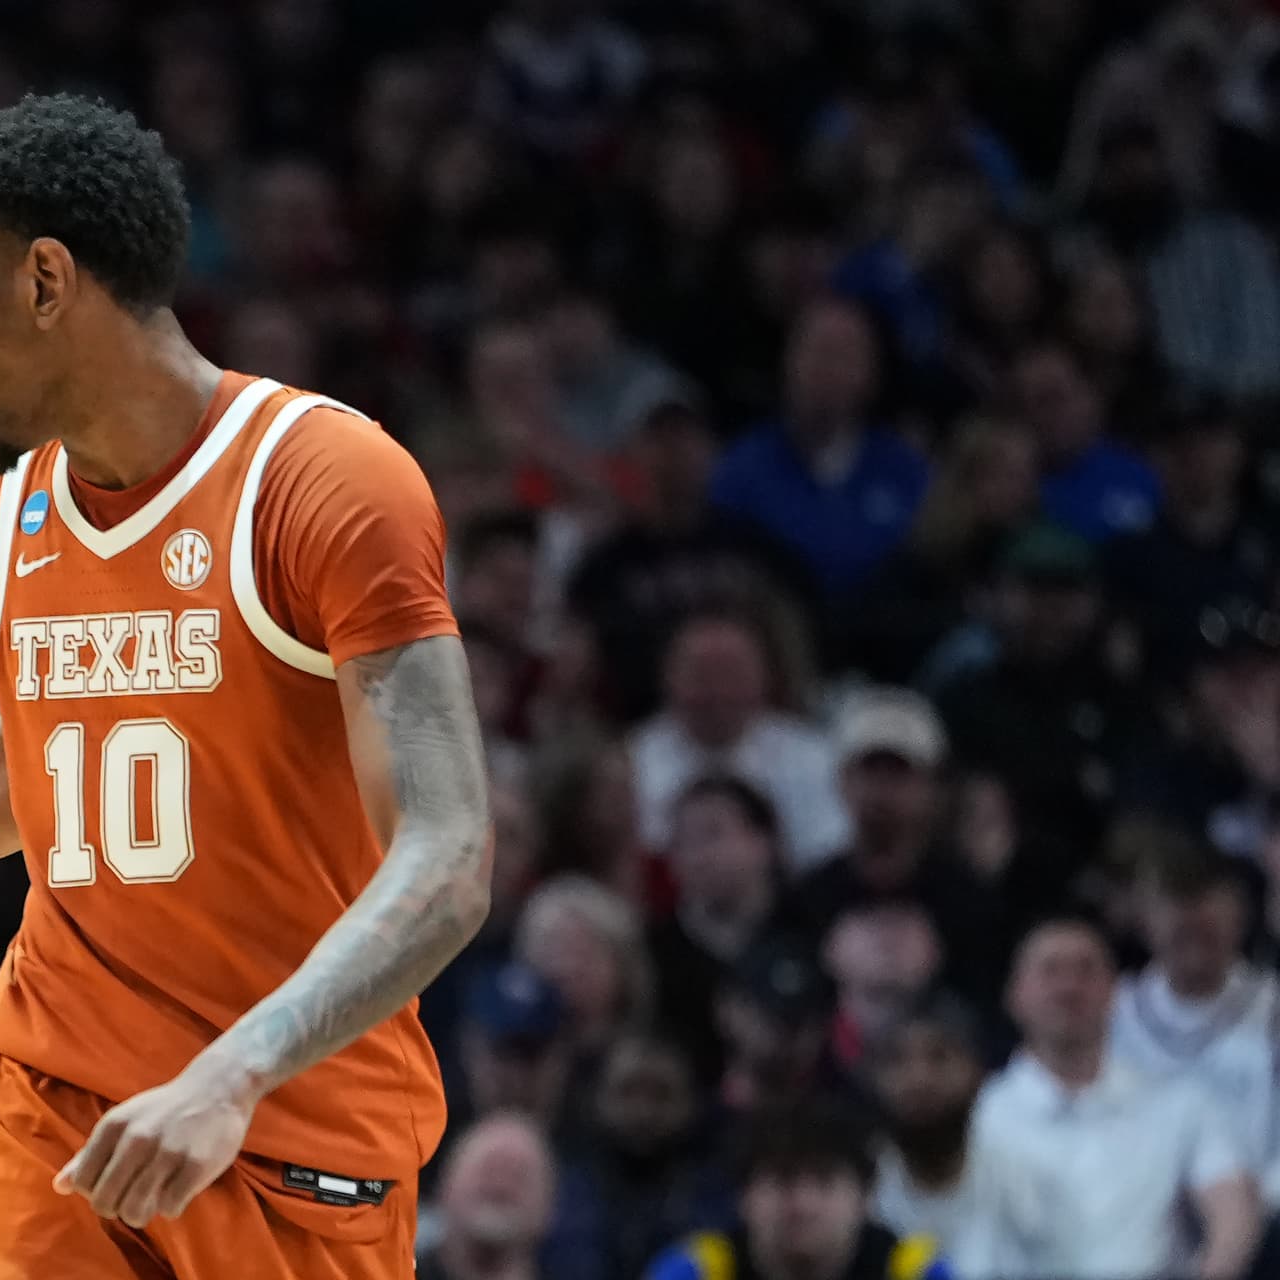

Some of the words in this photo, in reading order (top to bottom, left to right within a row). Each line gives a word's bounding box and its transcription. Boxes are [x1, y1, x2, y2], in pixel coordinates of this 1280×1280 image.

[166, 533, 209, 585] SEC
[11, 608, 223, 701] TEXAS
[44, 717, 195, 888] 10
